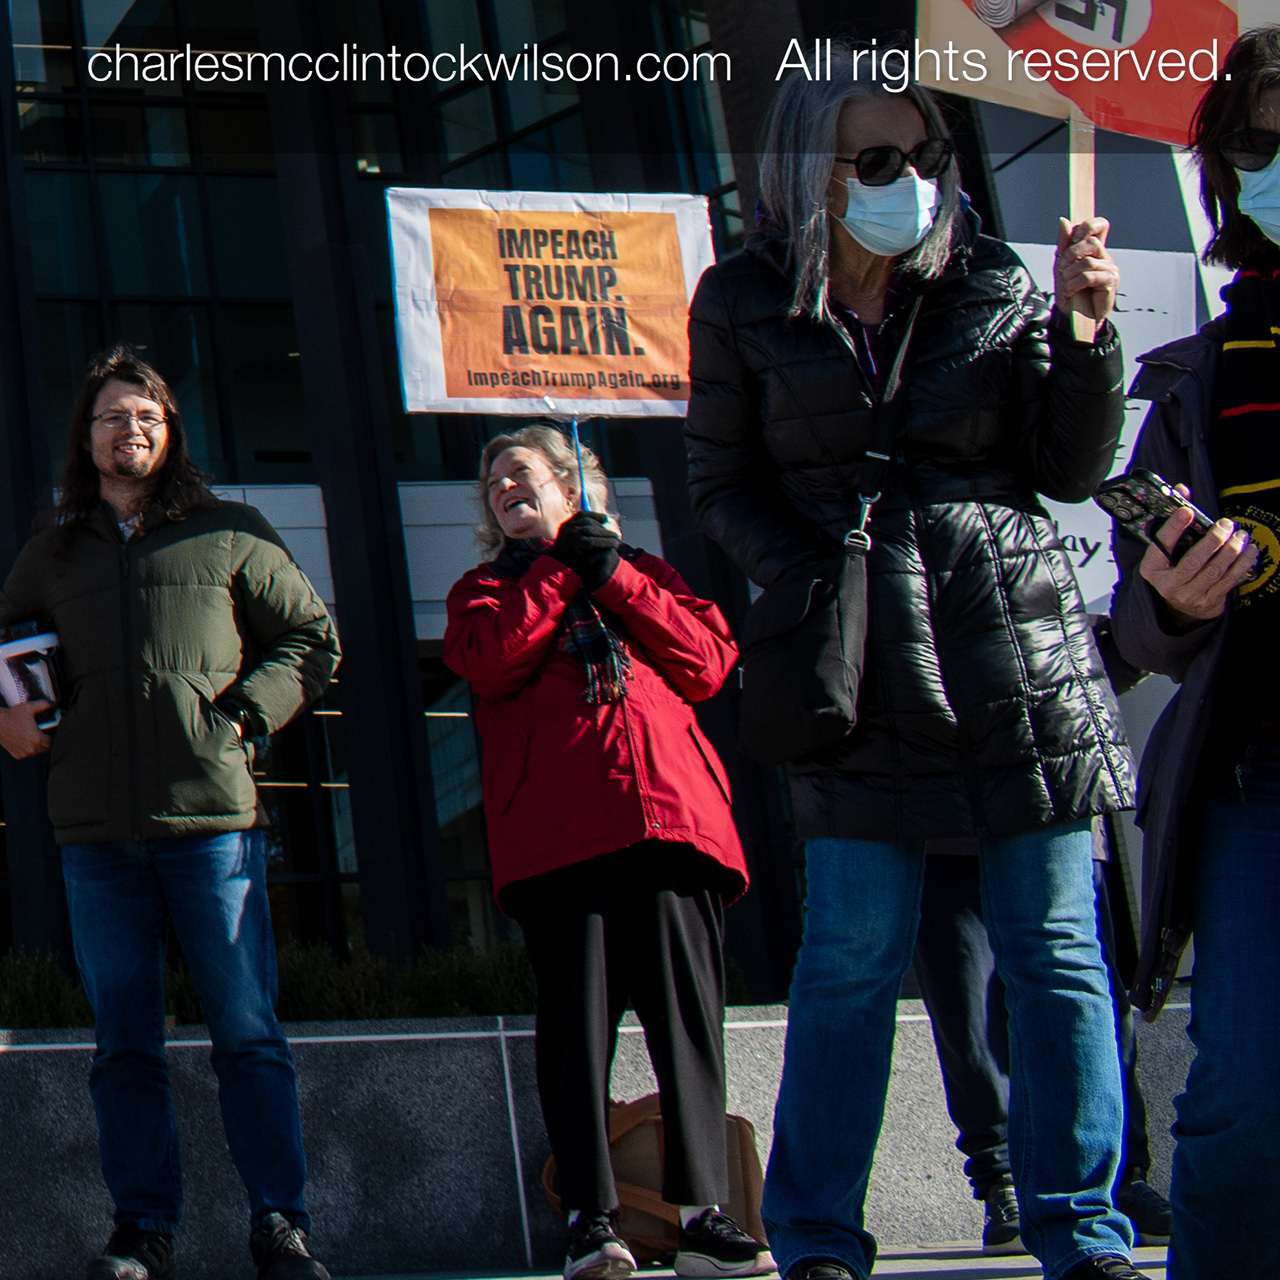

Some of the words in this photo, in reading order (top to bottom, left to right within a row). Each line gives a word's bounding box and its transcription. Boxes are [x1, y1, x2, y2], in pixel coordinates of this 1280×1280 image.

[497, 228, 618, 261] IMPEACH
[504, 264, 624, 302] TRUMP.
[503, 305, 646, 356] AGAIN.
[467, 369, 681, 391] ImpeachTrumpAgain.org
